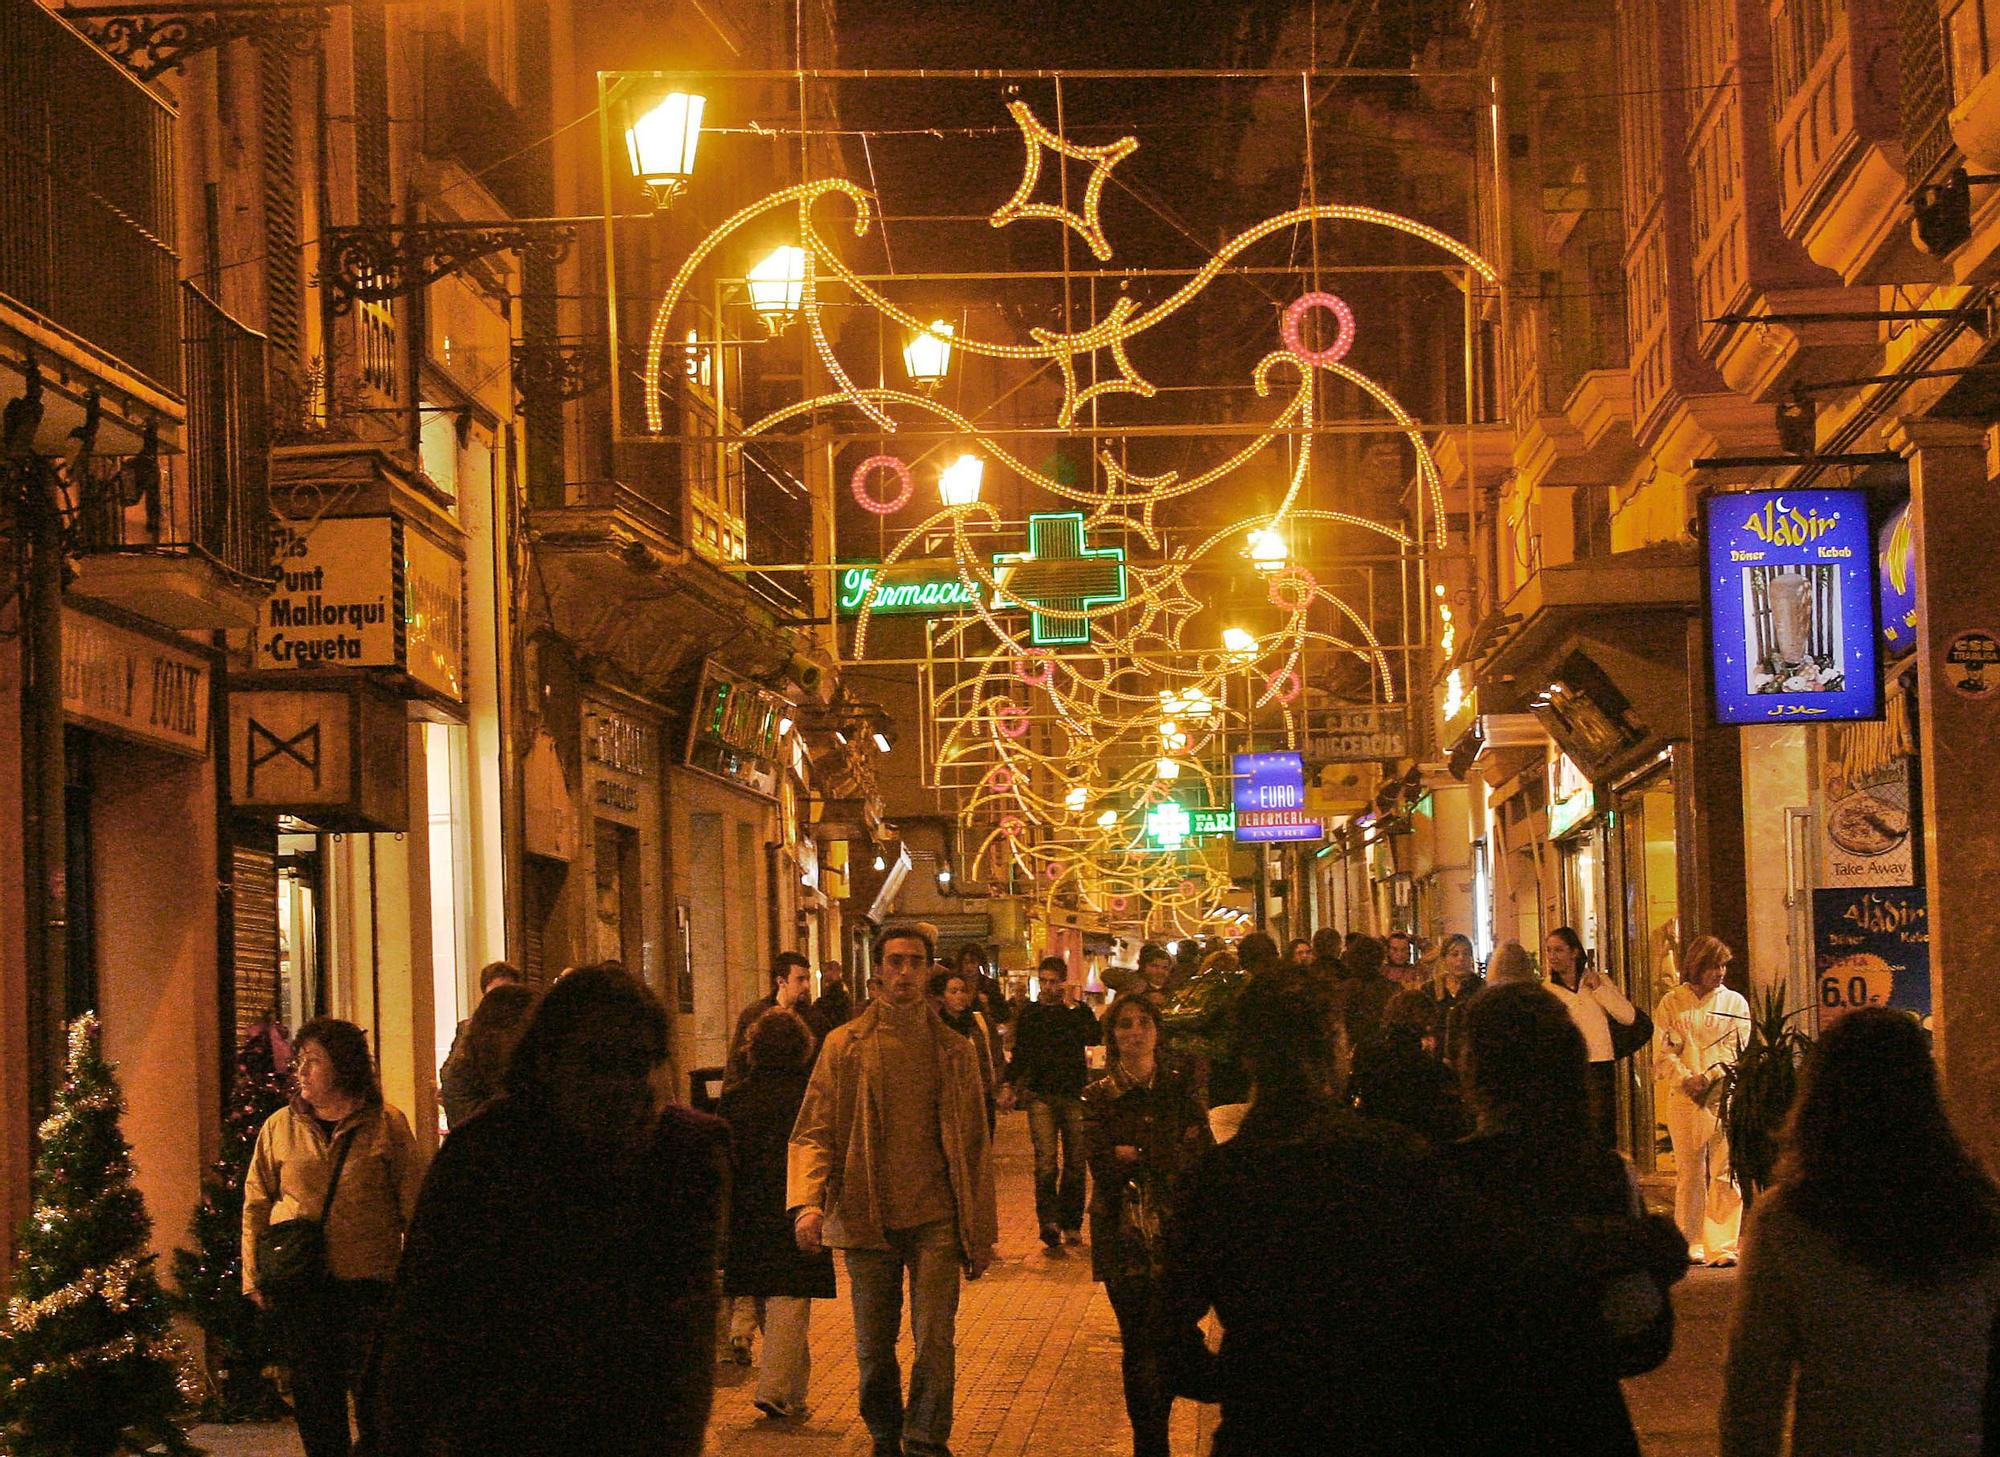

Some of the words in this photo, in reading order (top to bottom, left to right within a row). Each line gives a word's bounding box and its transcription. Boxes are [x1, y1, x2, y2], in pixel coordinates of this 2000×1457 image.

[1817, 546, 1852, 558] Kebab
[271, 565, 324, 592] Punt
[1260, 785, 1295, 809] EURO
[1833, 862, 1864, 876] Take
[1868, 861, 1907, 875] Away
